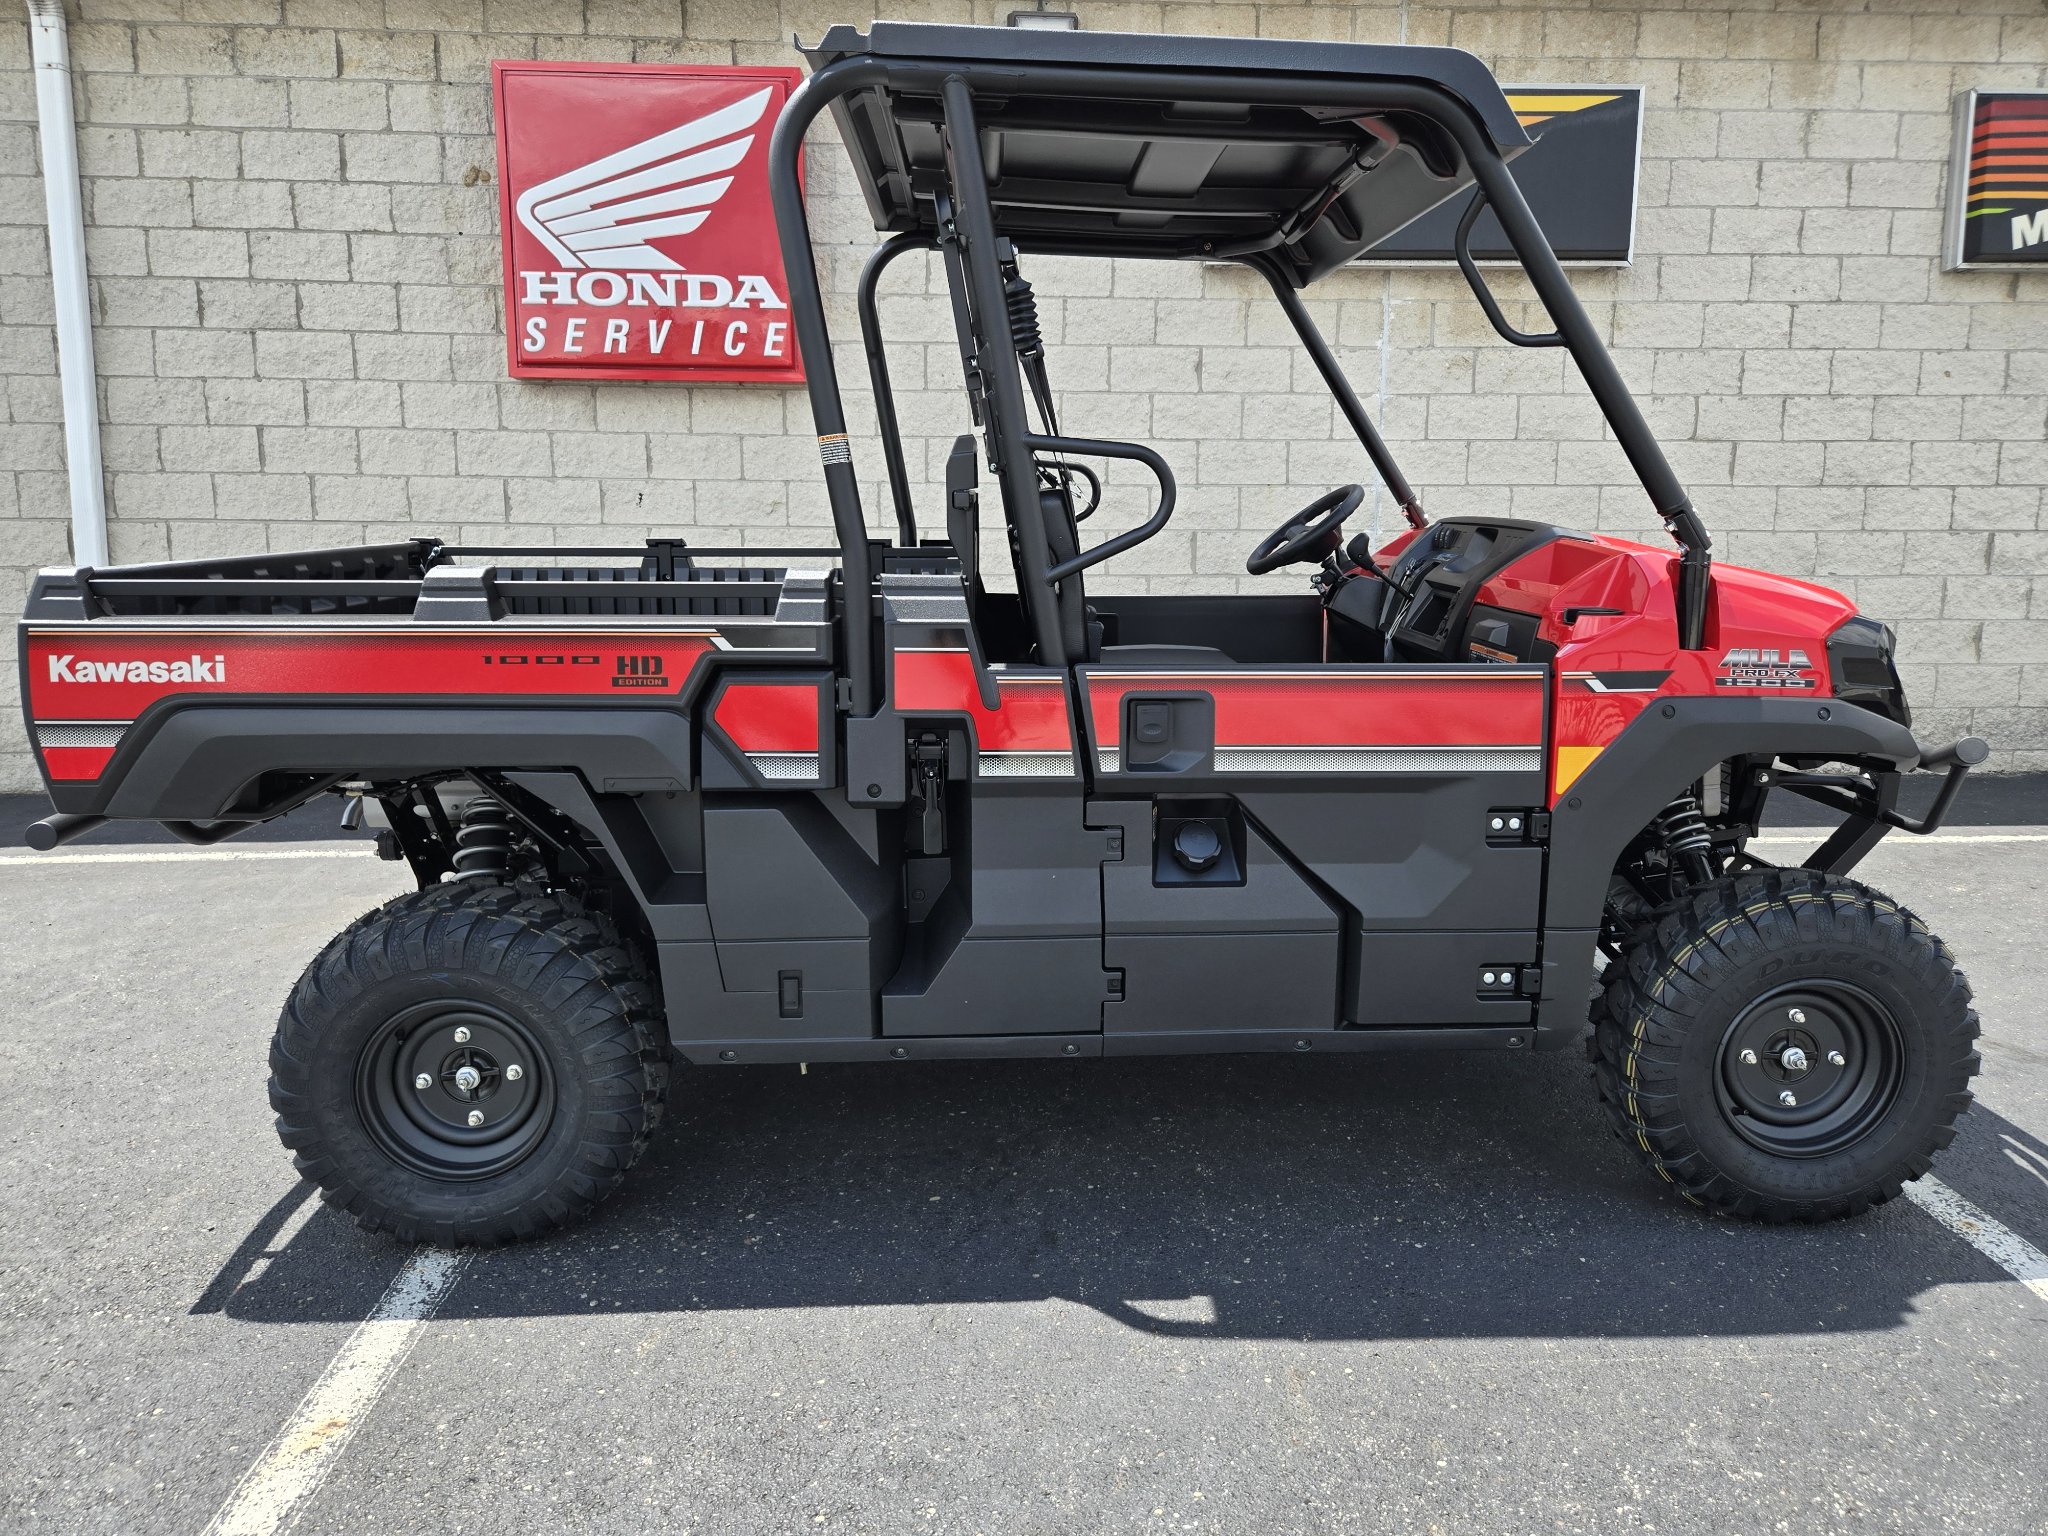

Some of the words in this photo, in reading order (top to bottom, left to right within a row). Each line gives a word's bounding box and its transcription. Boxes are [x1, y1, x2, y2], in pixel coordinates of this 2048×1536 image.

[520, 271, 787, 309] HONDA
[523, 316, 787, 356] SERVICE
[48, 654, 226, 684] Kawasaki
[481, 655, 600, 665] 1000
[616, 655, 663, 675] HD
[1718, 648, 1813, 669] MULE
[618, 678, 662, 686] EDITION
